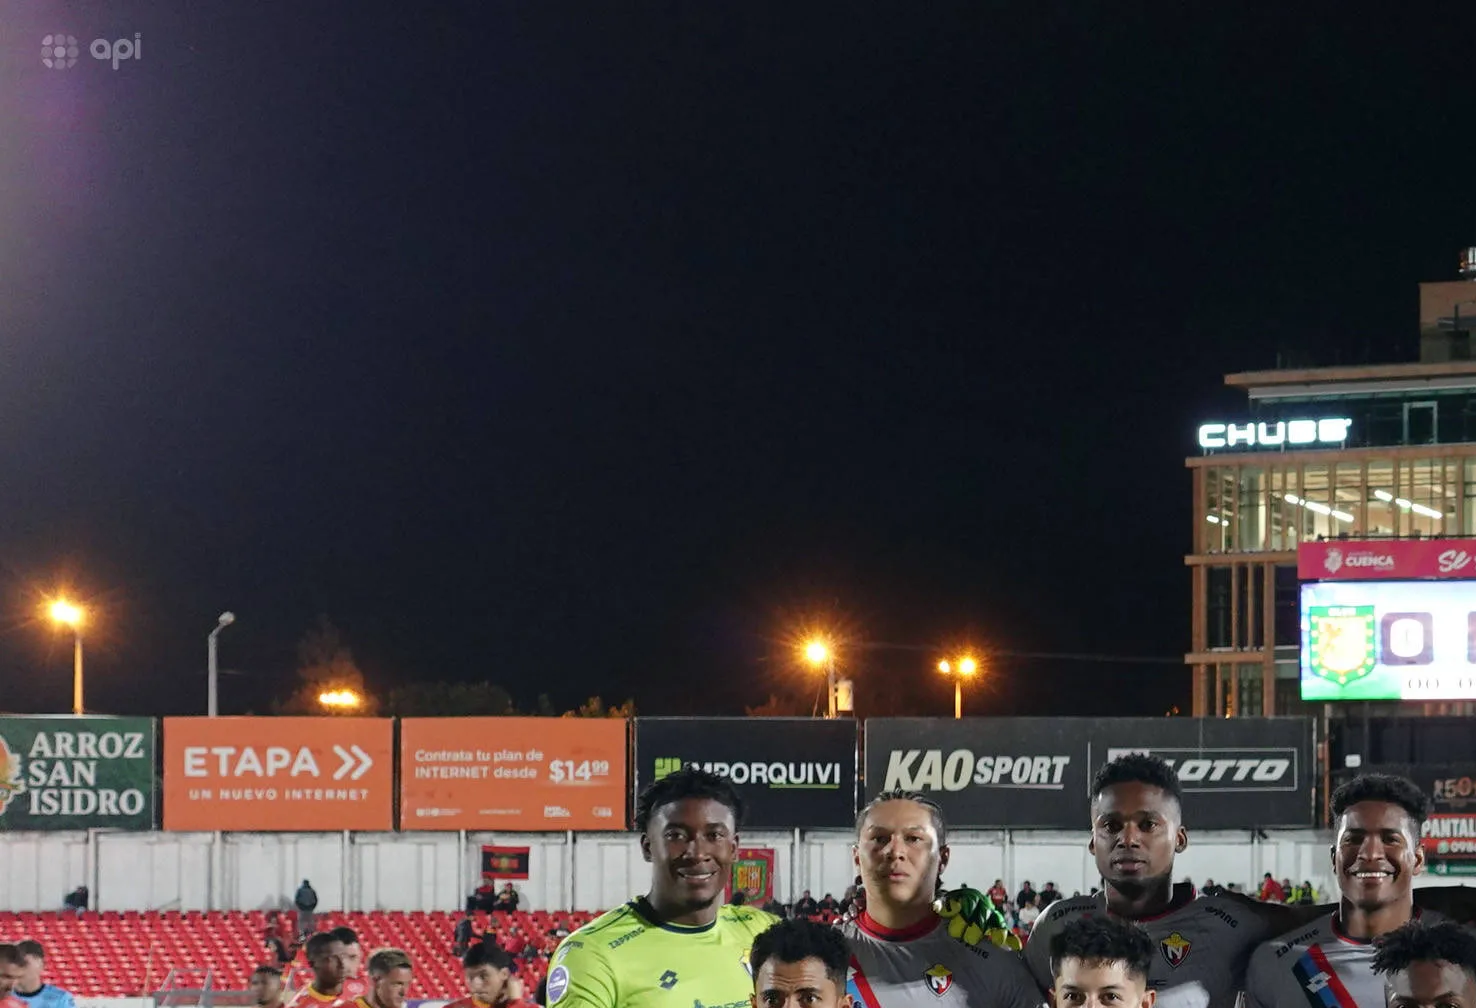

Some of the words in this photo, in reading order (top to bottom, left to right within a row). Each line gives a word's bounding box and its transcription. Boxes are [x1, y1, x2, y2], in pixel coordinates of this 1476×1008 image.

[1345, 555, 1394, 567] CUENCA
[28, 731, 145, 758] ARROZ
[183, 747, 320, 777] ETAPA
[415, 749, 474, 763] Contrata
[476, 749, 492, 762] tu
[494, 749, 523, 765] plan
[526, 748, 544, 762] de
[28, 760, 98, 787] SAN
[415, 765, 489, 779] INTERNET
[493, 766, 537, 779] desde
[690, 763, 840, 784] MPORQUIVI
[28, 788, 145, 815] ISIDRO
[188, 789, 213, 800] UN
[219, 788, 278, 801] NUEVO
[285, 788, 369, 801] INTERNET
